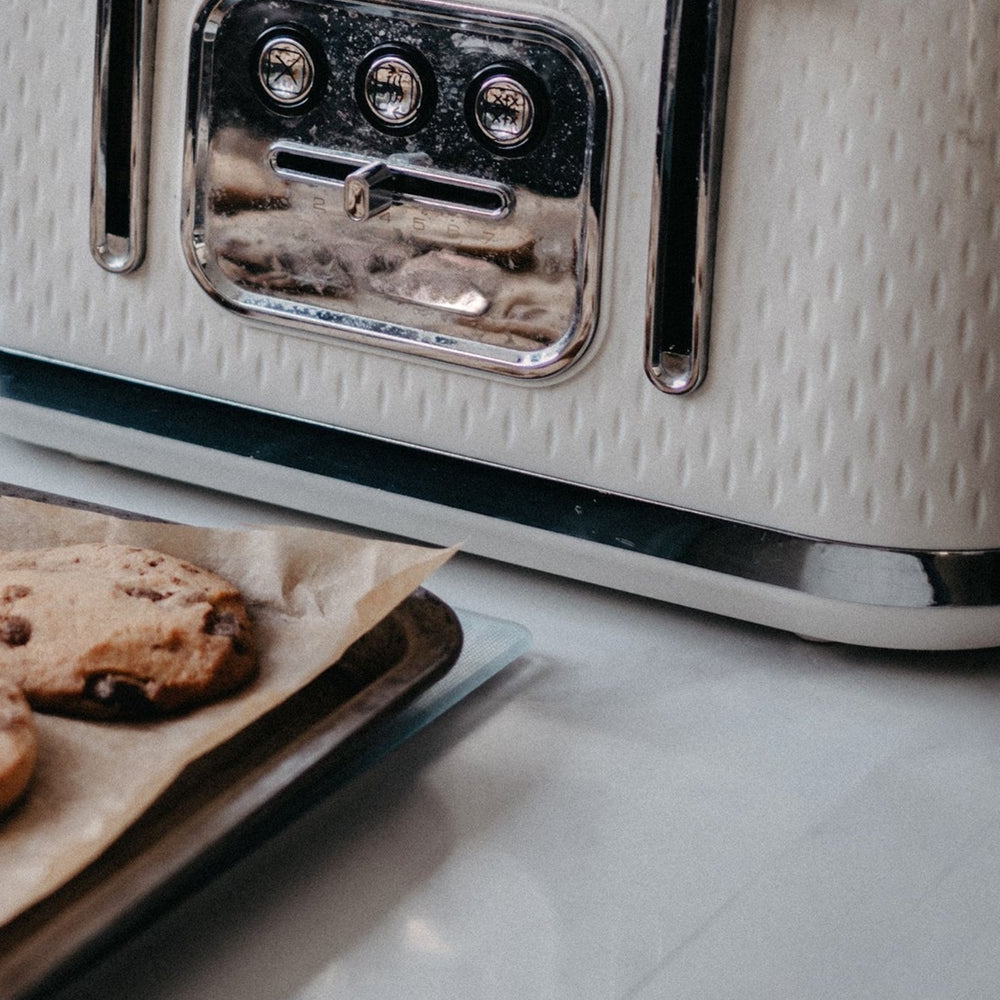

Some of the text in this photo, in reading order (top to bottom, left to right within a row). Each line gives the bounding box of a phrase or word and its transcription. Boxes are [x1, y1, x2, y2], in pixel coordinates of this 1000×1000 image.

[312, 197, 496, 244] 2 4 5 6 7
